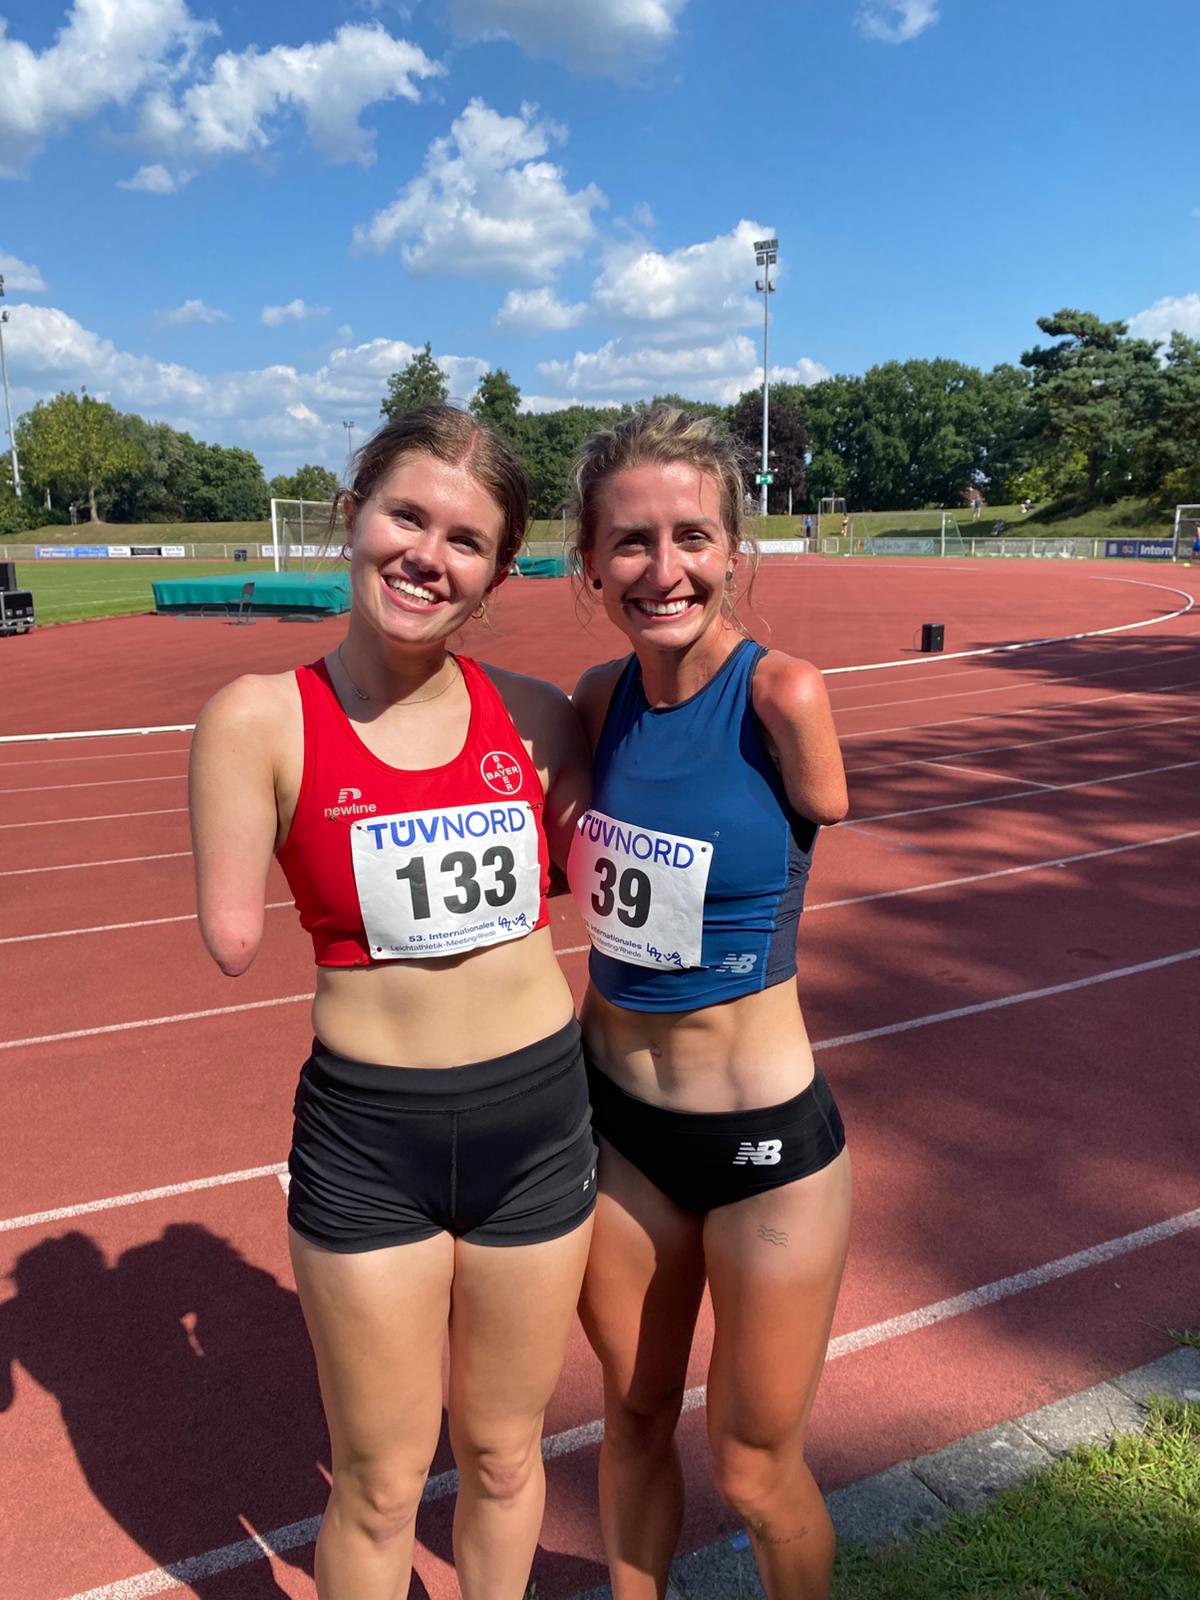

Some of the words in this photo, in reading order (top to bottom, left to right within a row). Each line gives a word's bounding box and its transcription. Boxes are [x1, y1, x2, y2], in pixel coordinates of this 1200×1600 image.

[486, 766, 519, 781] BAYER
[324, 803, 377, 817] newline
[395, 845, 517, 920] 133
[591, 857, 652, 929] 39
[408, 934, 426, 943] 53.
[428, 920, 495, 941] Internationales
